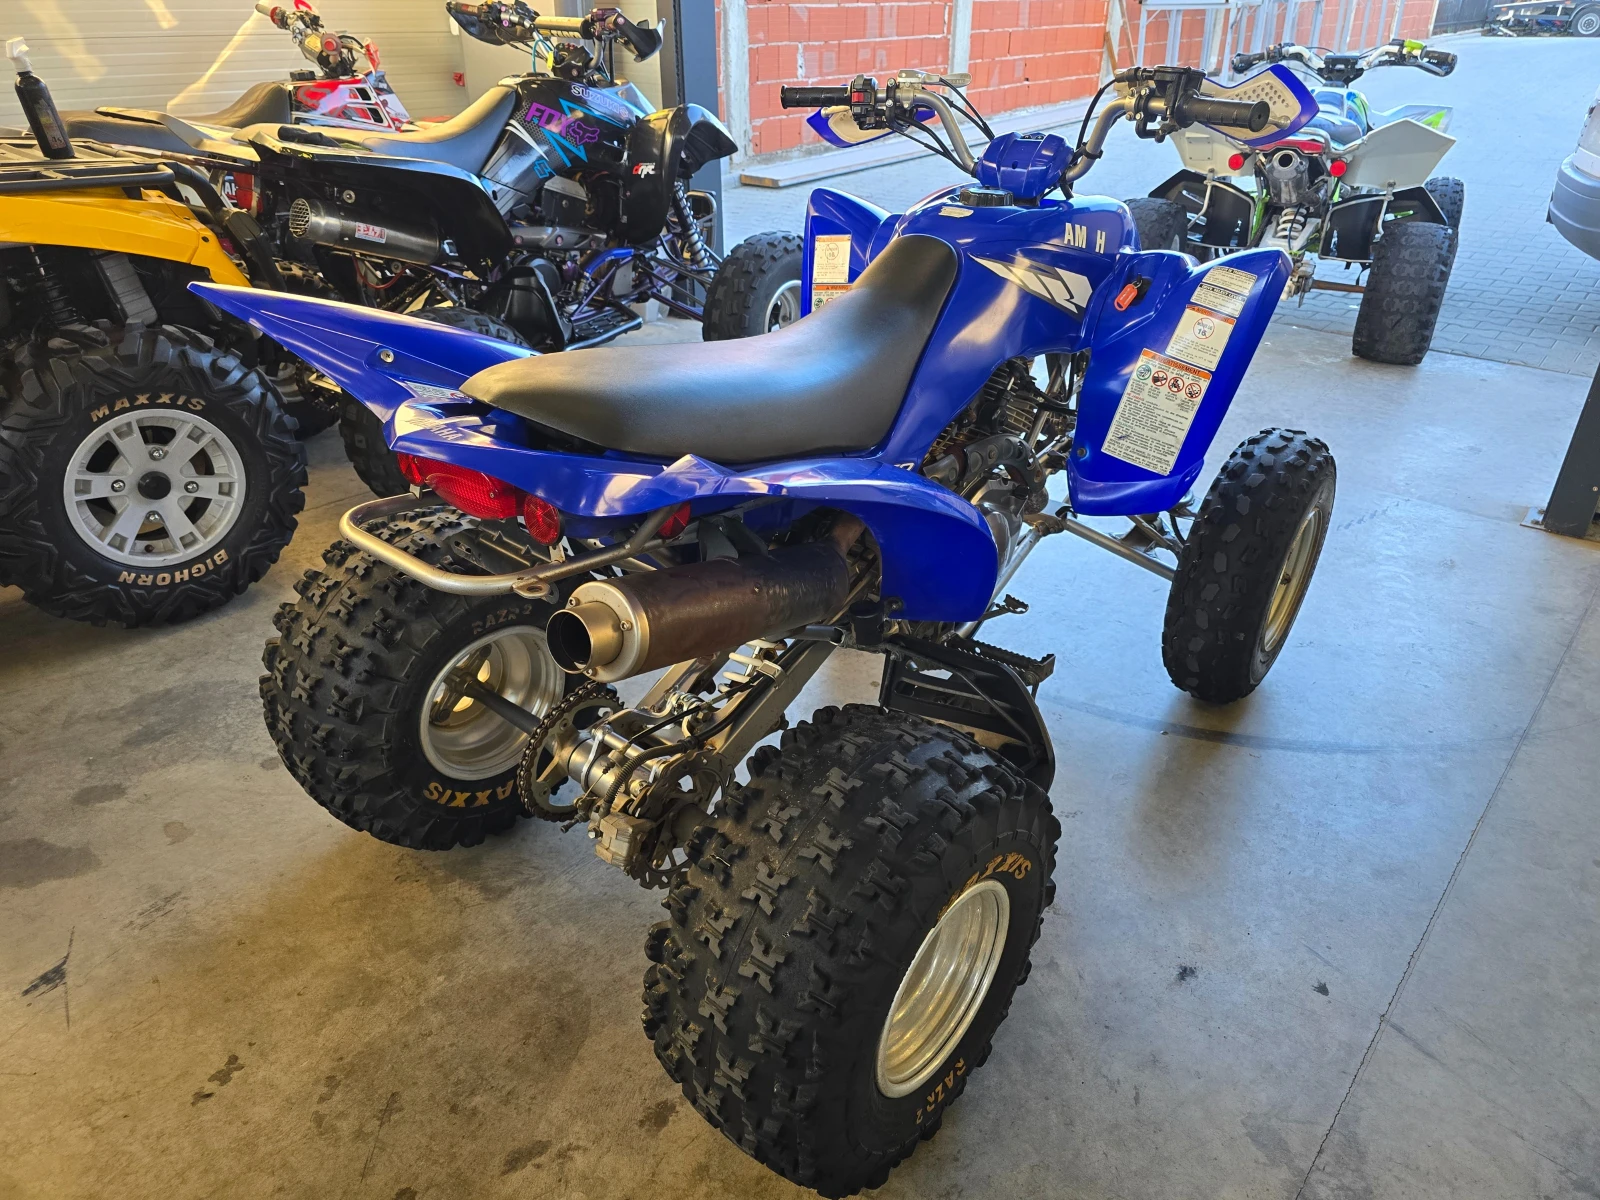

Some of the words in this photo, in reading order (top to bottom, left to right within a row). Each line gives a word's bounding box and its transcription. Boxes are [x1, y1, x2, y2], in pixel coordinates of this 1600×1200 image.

[571, 84, 620, 115] SUZUKI
[525, 102, 574, 137] FOX
[90, 392, 206, 422] MAXXIS
[118, 548, 229, 586] BIGHORN
[423, 779, 514, 808] AXXIS
